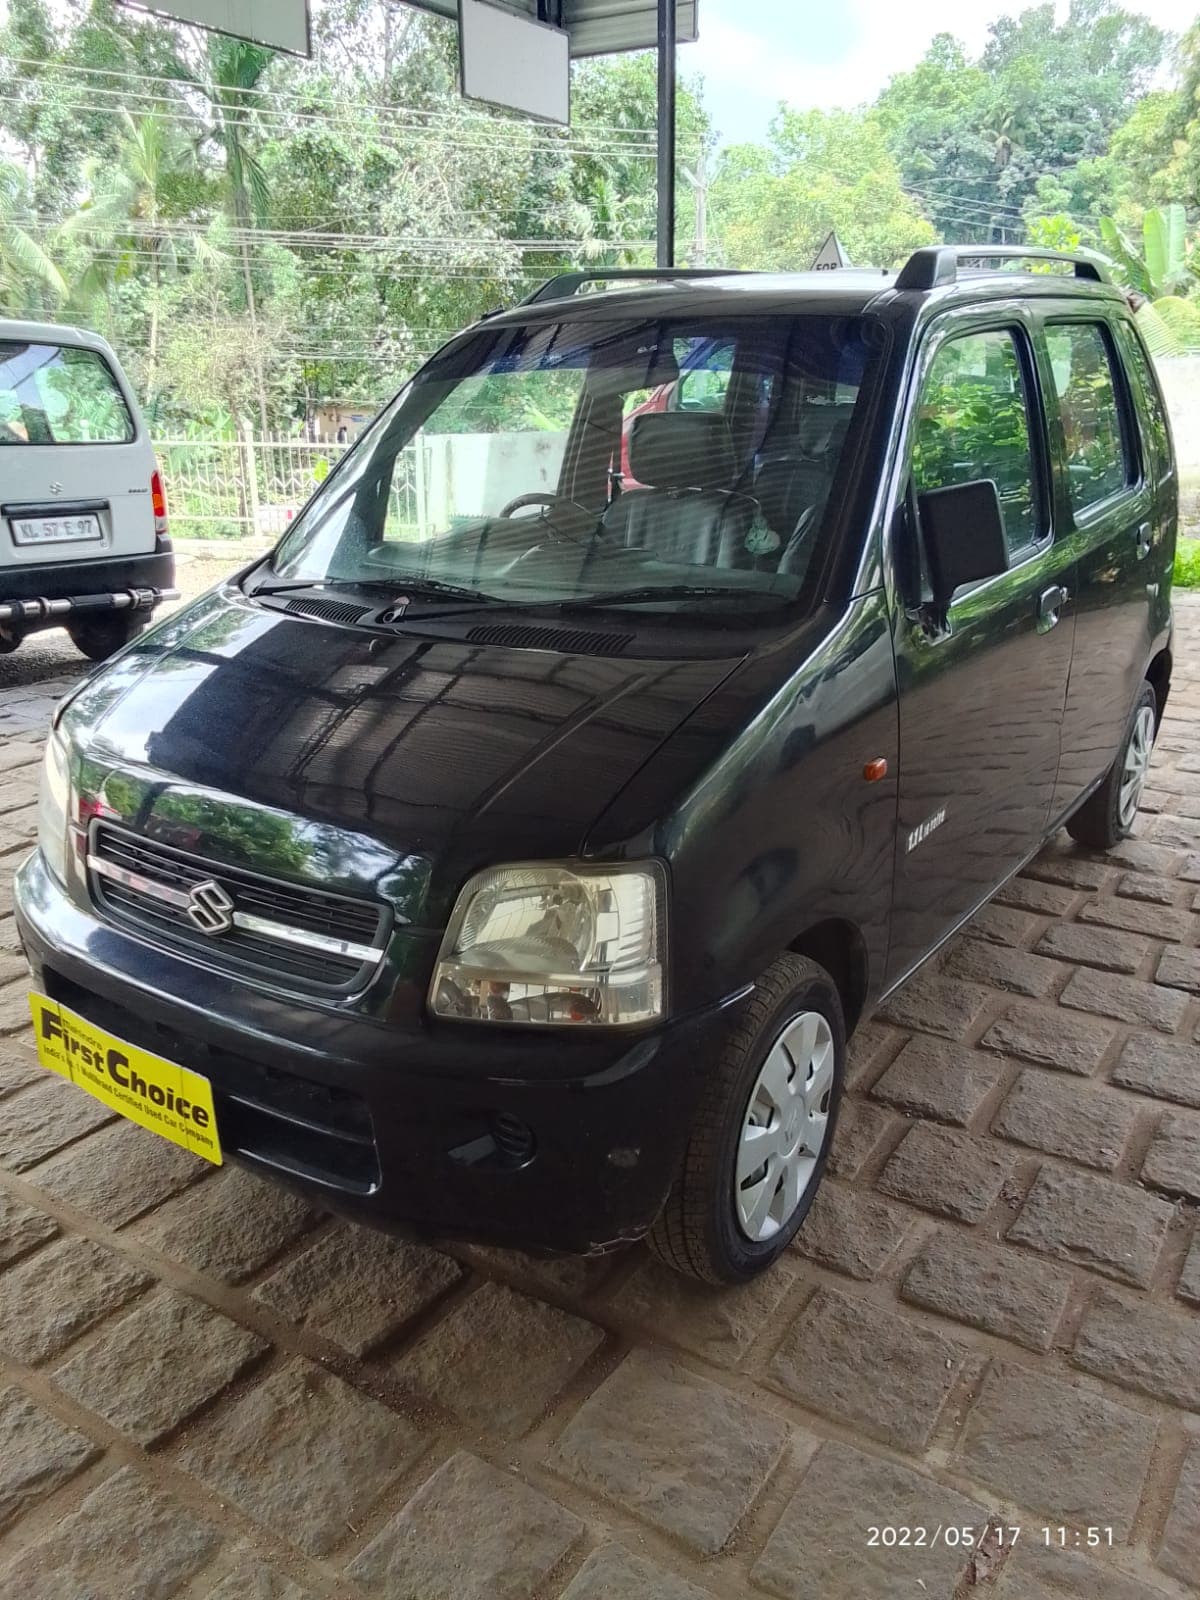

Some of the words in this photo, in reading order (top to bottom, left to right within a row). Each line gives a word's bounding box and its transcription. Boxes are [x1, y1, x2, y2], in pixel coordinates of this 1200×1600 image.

[143, 1104, 163, 1122] Used
[163, 1114, 178, 1129] Car
[178, 1121, 214, 1150] Company
